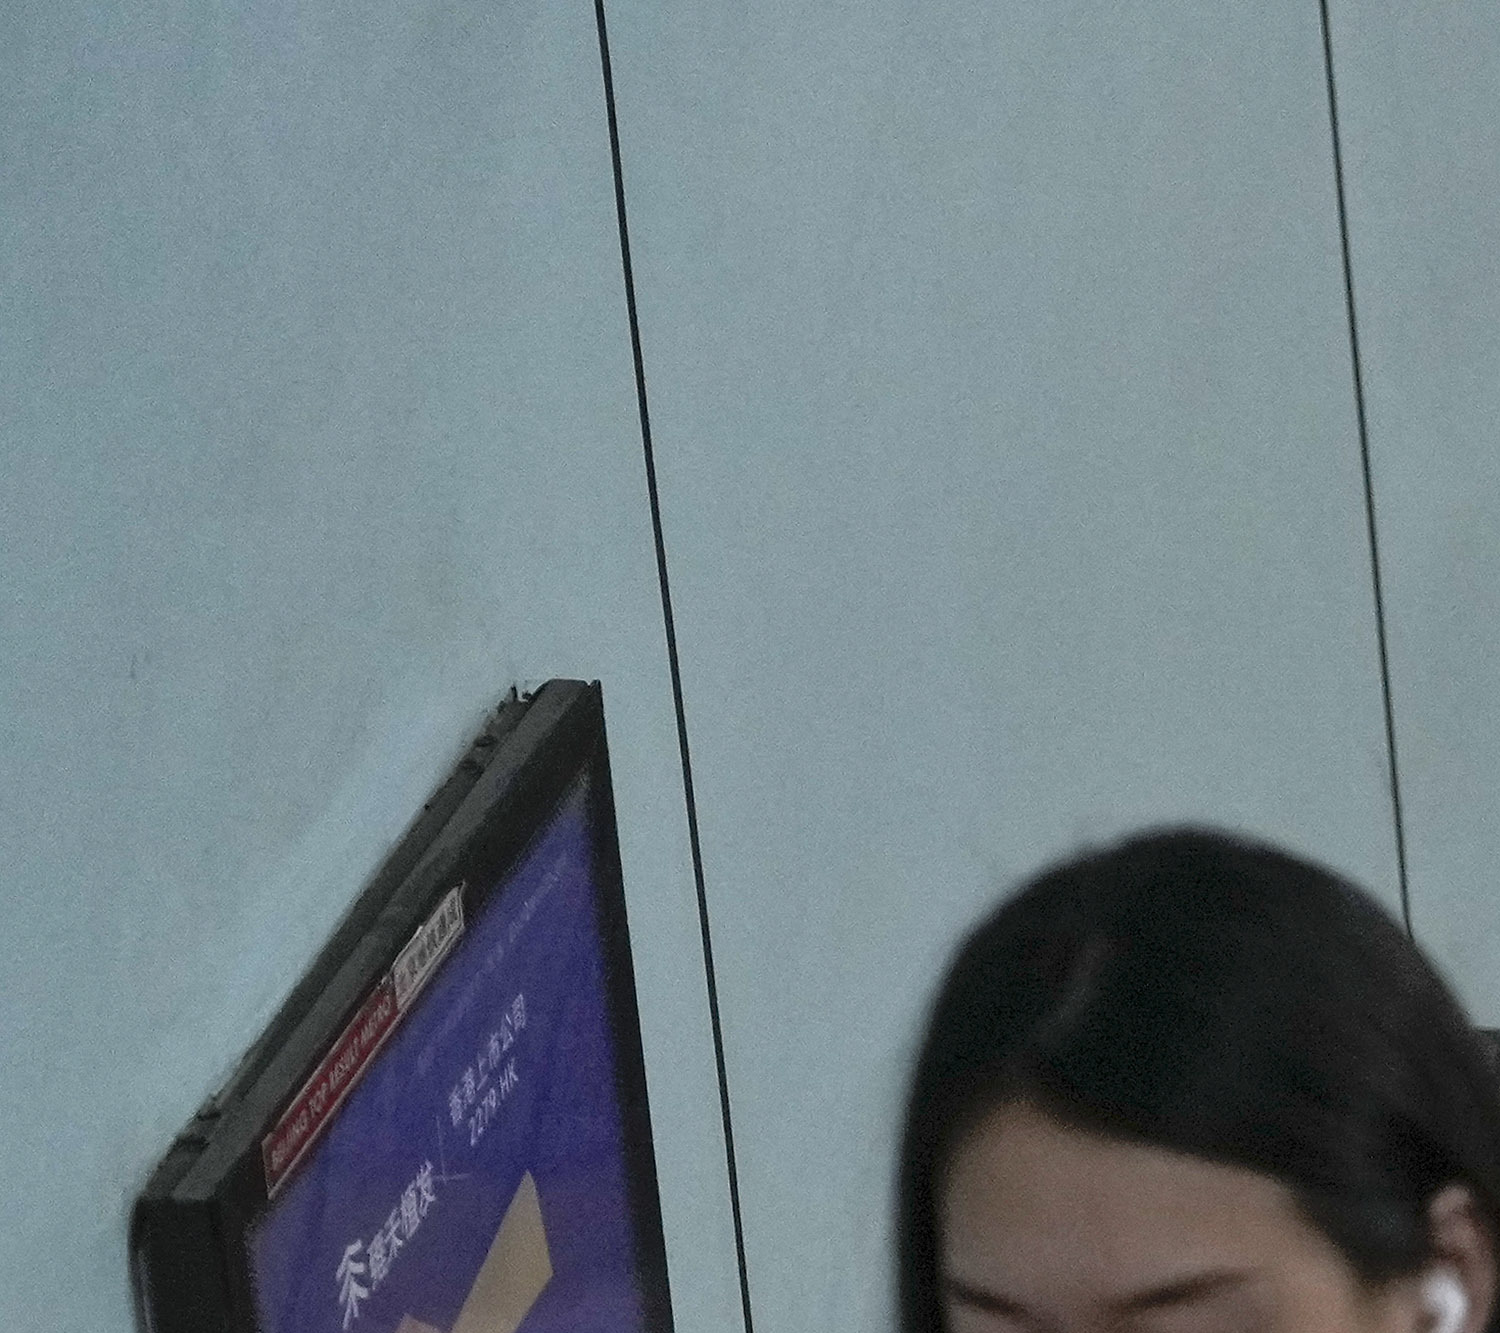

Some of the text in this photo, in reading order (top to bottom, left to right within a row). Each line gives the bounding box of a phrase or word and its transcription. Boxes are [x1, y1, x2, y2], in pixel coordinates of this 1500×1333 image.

[450, 993, 527, 1126] 香港上市公司
